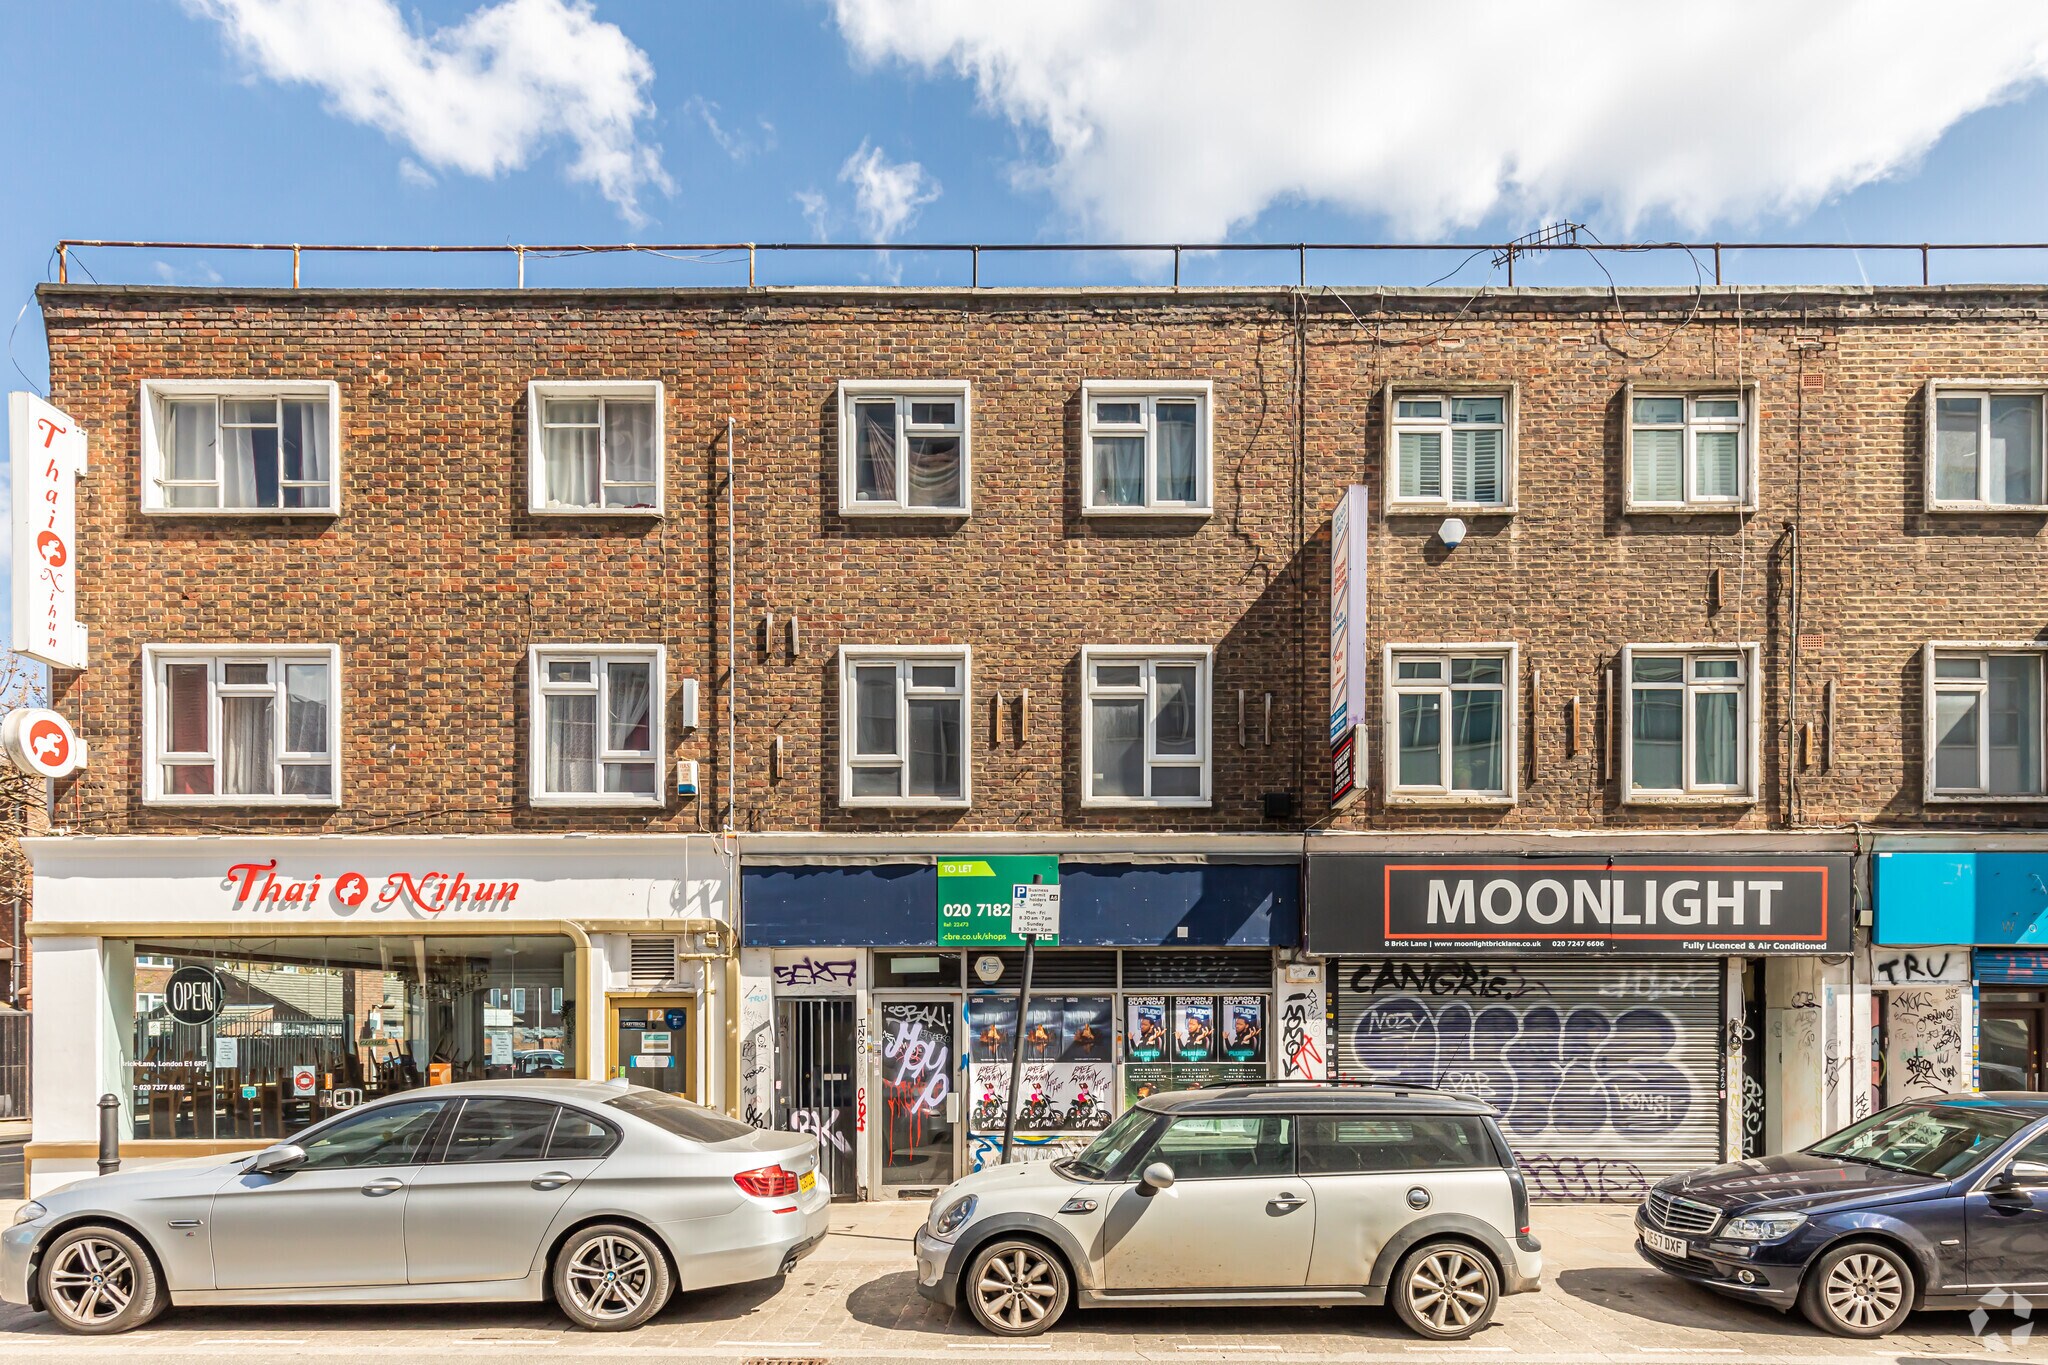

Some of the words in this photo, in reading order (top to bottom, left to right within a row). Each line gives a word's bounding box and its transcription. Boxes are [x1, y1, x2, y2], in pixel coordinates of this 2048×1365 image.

[38, 418, 67, 529] Thai
[40, 568, 64, 648] Nihun
[944, 865, 956, 873] TO
[958, 865, 972, 873] LET
[227, 859, 322, 902] Thai
[379, 872, 519, 912] Nihun
[1017, 887, 1026, 898] P
[1427, 879, 1783, 925] MOONLIGHT
[943, 904, 972, 917] 020
[976, 904, 1012, 917] 7182
[944, 932, 1006, 942] cbre.co.uk/shops
[1683, 942, 1704, 950] Fully
[1878, 953, 1950, 985] TRU
[173, 982, 213, 1011] OPEN
[650, 1010, 664, 1020] 12
[982, 1120, 992, 1128] OUT
[1029, 1120, 1040, 1128] OUT
[1076, 1120, 1086, 1128] OUT
[1664, 1237, 1682, 1253] DXF
